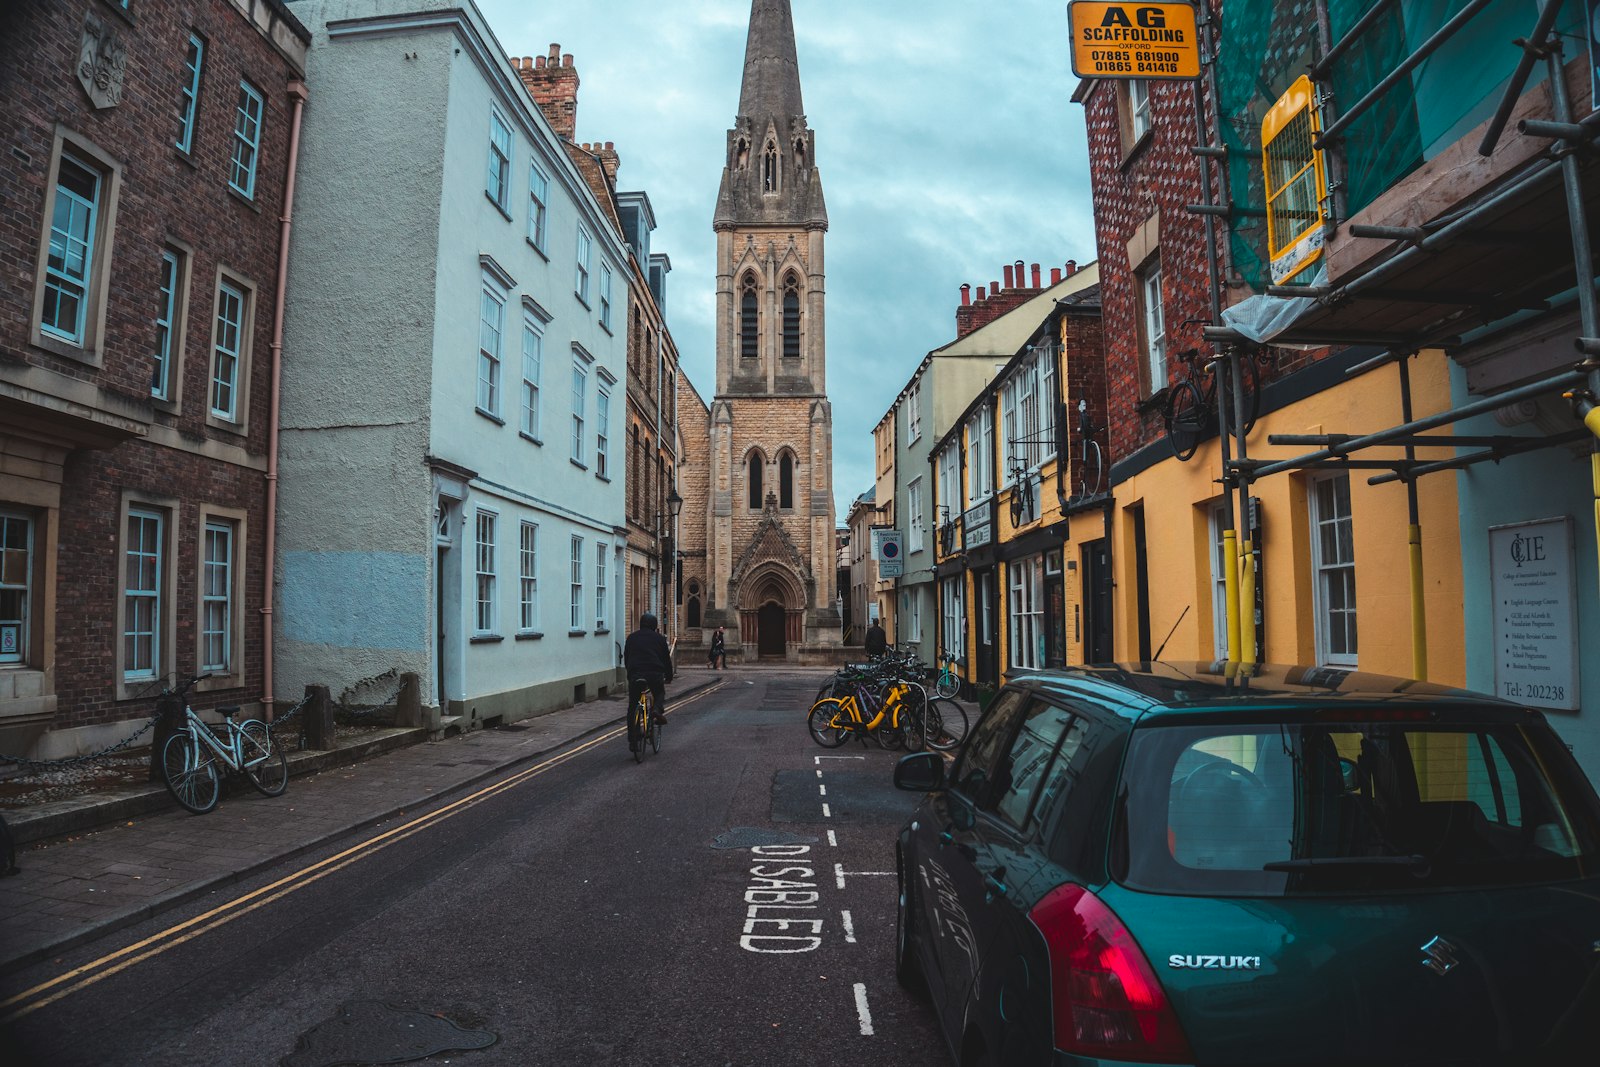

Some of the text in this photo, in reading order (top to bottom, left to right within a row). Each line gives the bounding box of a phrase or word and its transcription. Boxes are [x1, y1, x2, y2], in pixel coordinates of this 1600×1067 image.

[1101, 7, 1165, 28] AG
[1083, 28, 1184, 42] SCAFFOLDING
[1092, 51, 1179, 62] 07885 681900
[1095, 62, 1177, 72] 01865 841416
[1504, 682, 1564, 700] Tel: 202238
[740, 845, 823, 953] DISABLED
[1169, 954, 1260, 969] SUZUKI
